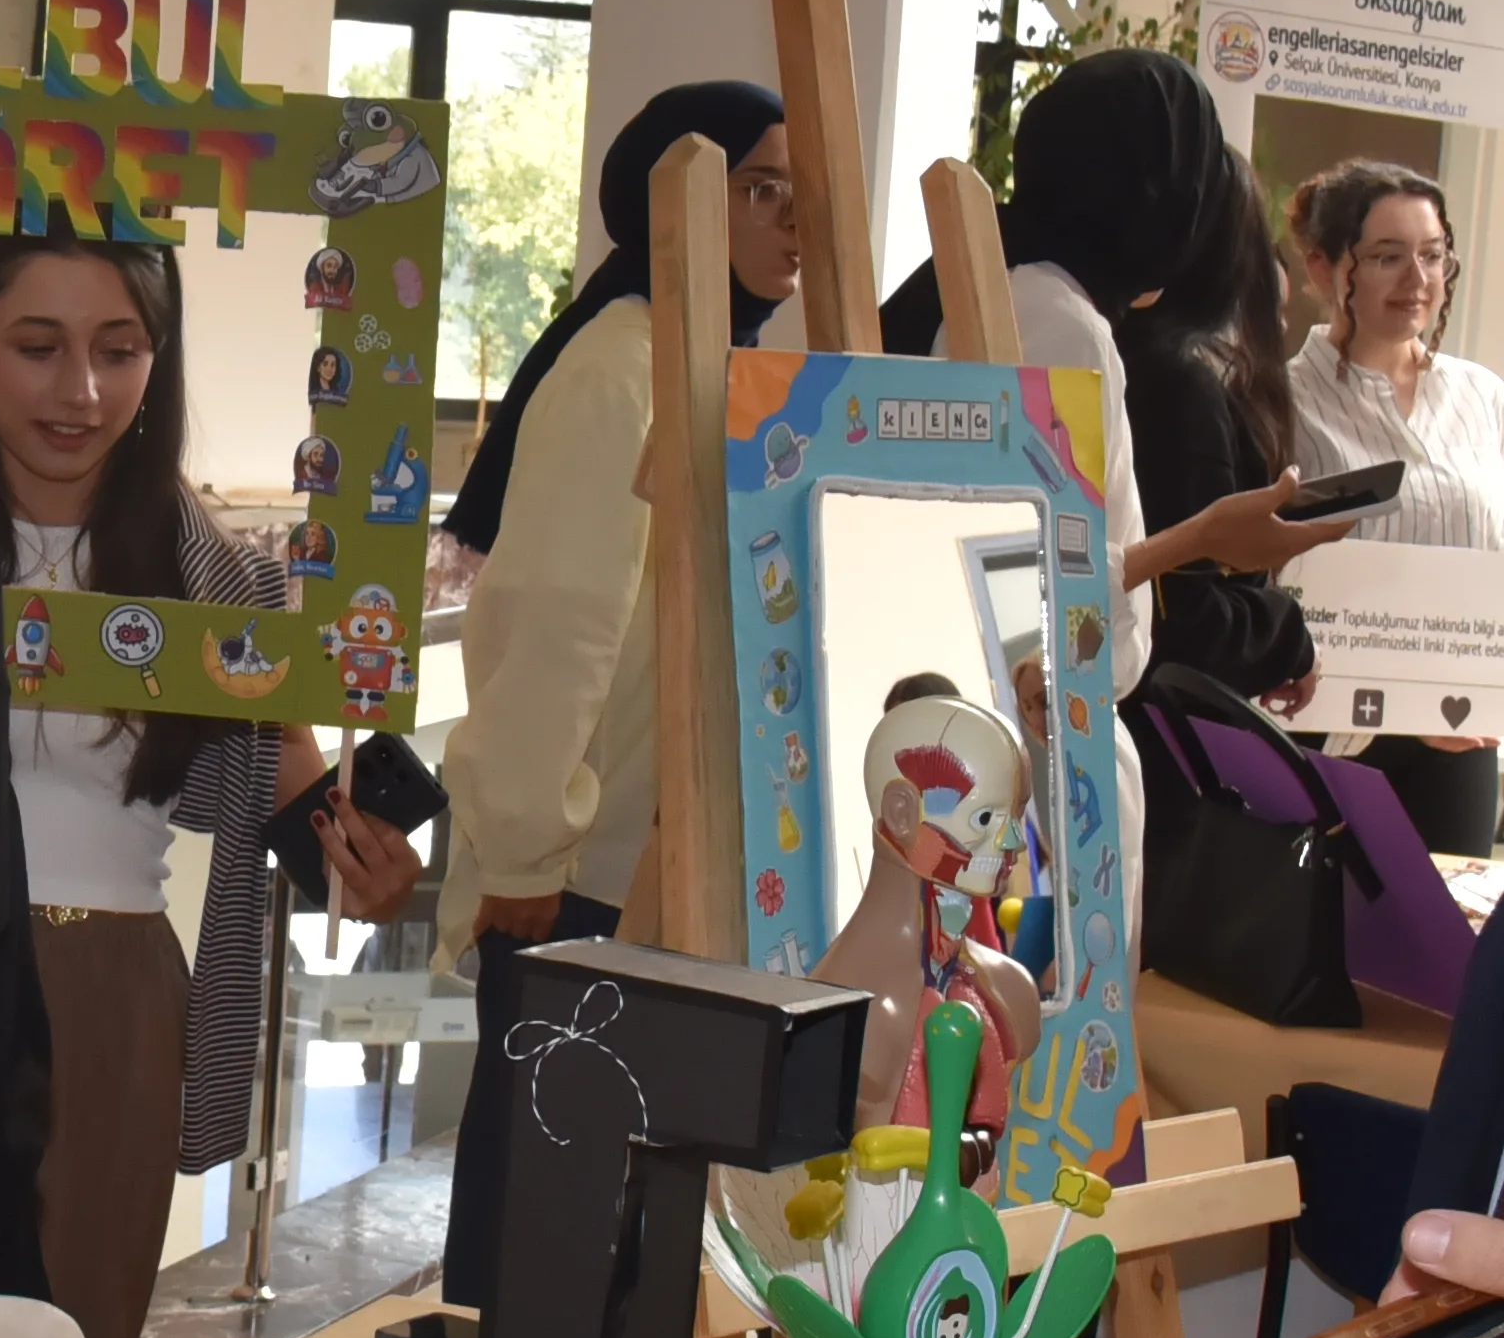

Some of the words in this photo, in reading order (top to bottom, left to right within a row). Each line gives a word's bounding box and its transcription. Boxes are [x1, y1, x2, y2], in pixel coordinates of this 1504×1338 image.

[1268, 25, 1465, 73] engelleriasanengelsizler
[1284, 51, 1325, 76] Selçuk
[1404, 70, 1442, 93] Konya
[1472, 618, 1496, 639] bilgi
[1447, 639, 1482, 658] ziyaret
